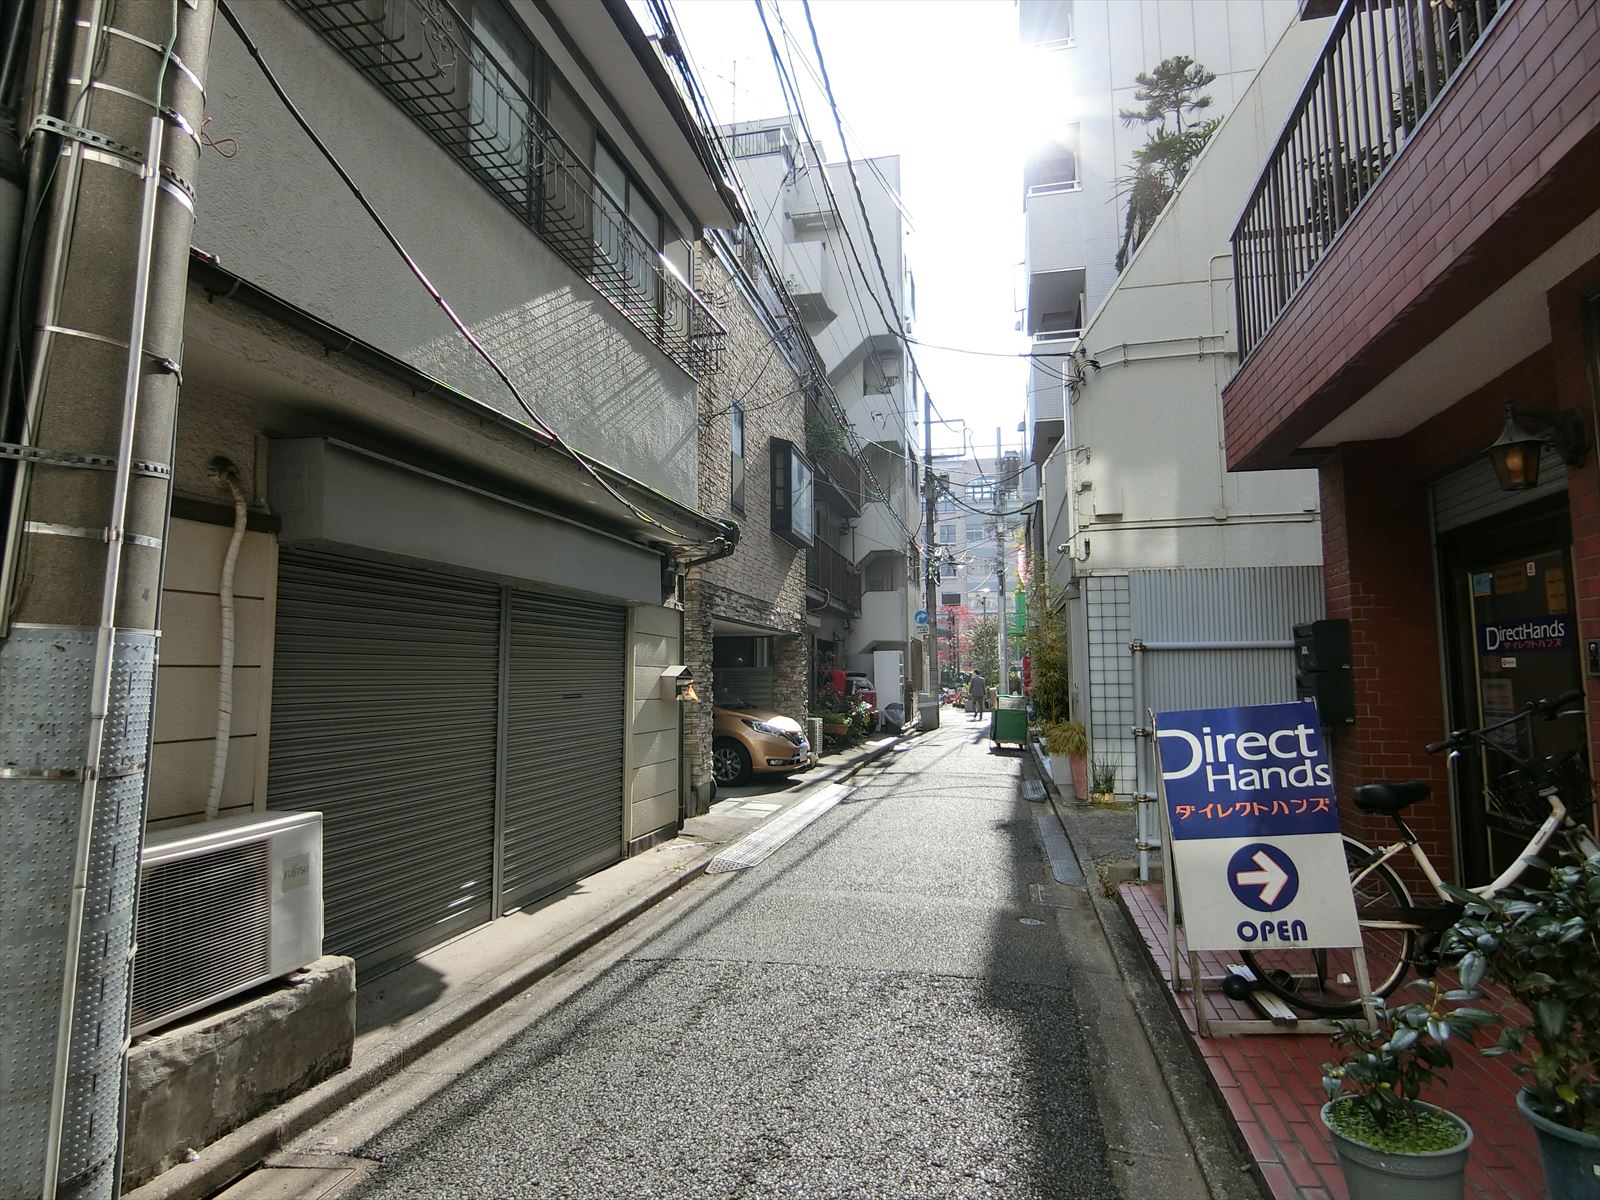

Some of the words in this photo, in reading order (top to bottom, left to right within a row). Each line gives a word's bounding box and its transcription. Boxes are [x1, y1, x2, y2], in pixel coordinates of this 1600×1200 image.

[1486, 620, 1565, 650] DirectHands
[1157, 723, 1318, 780] Direct
[1206, 759, 1331, 792] Hands
[1175, 797, 1329, 820] ダイレクトハンズ
[284, 865, 308, 878] FUJITSU
[1236, 919, 1308, 942] OPEN
